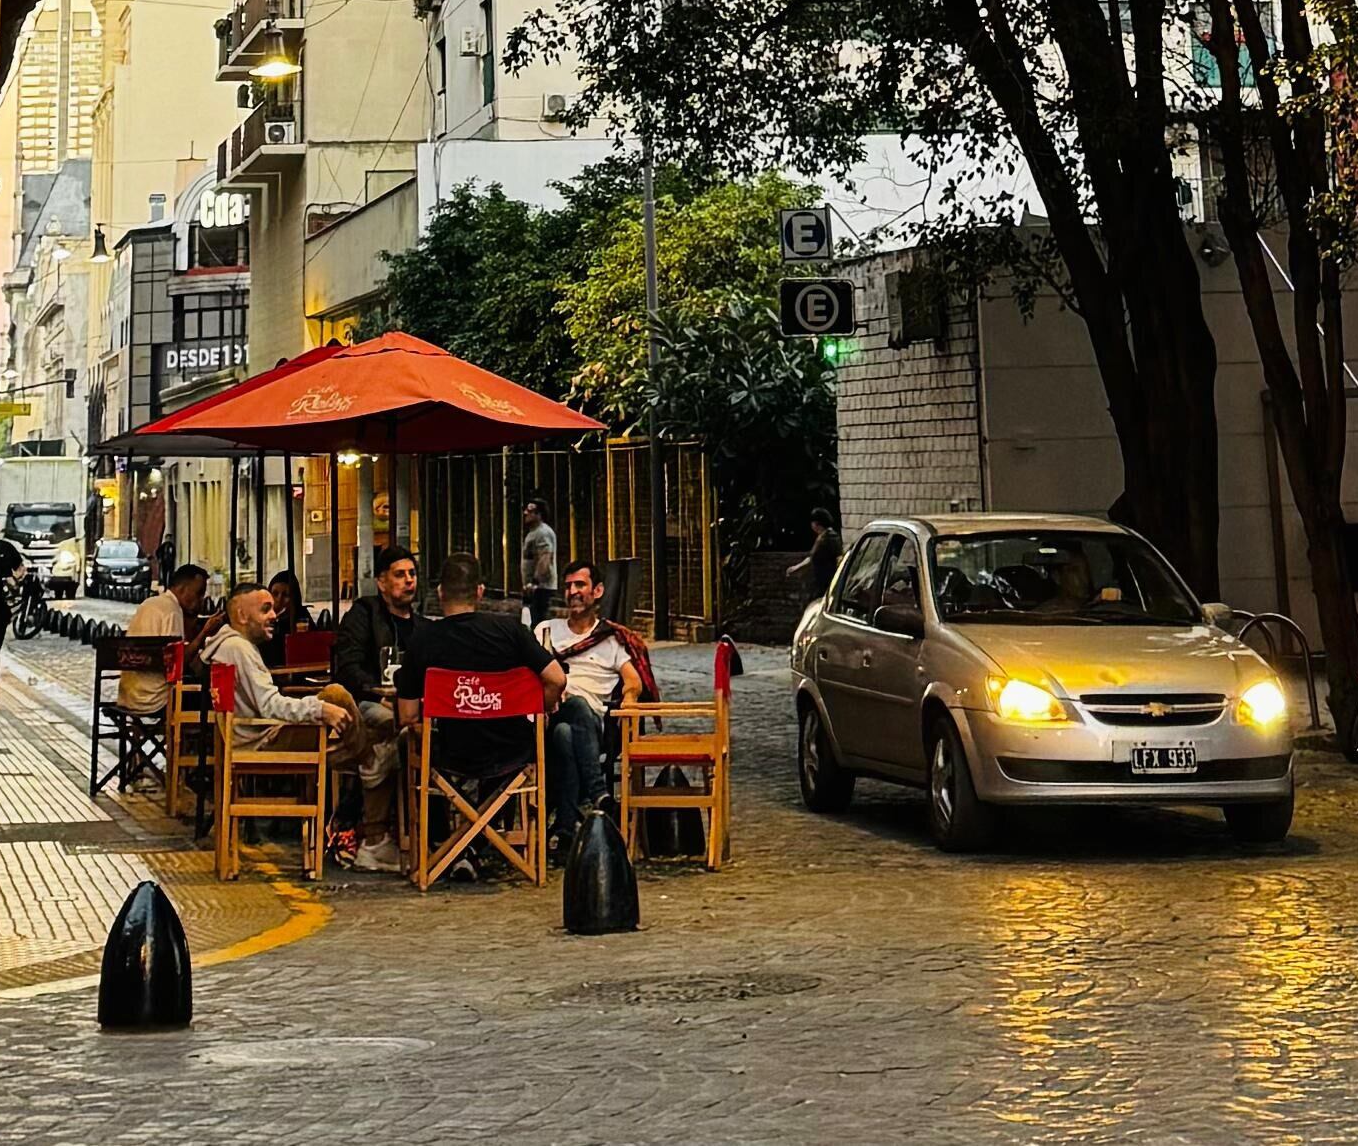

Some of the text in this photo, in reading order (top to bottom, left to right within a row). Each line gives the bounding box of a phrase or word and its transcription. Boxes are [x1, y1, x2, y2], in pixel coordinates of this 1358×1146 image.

[792, 215, 819, 252] E
[807, 294, 827, 321] E
[166, 347, 221, 369] DESDE
[453, 685, 502, 711] Relax
[1133, 749, 1195, 768] LFX 933
